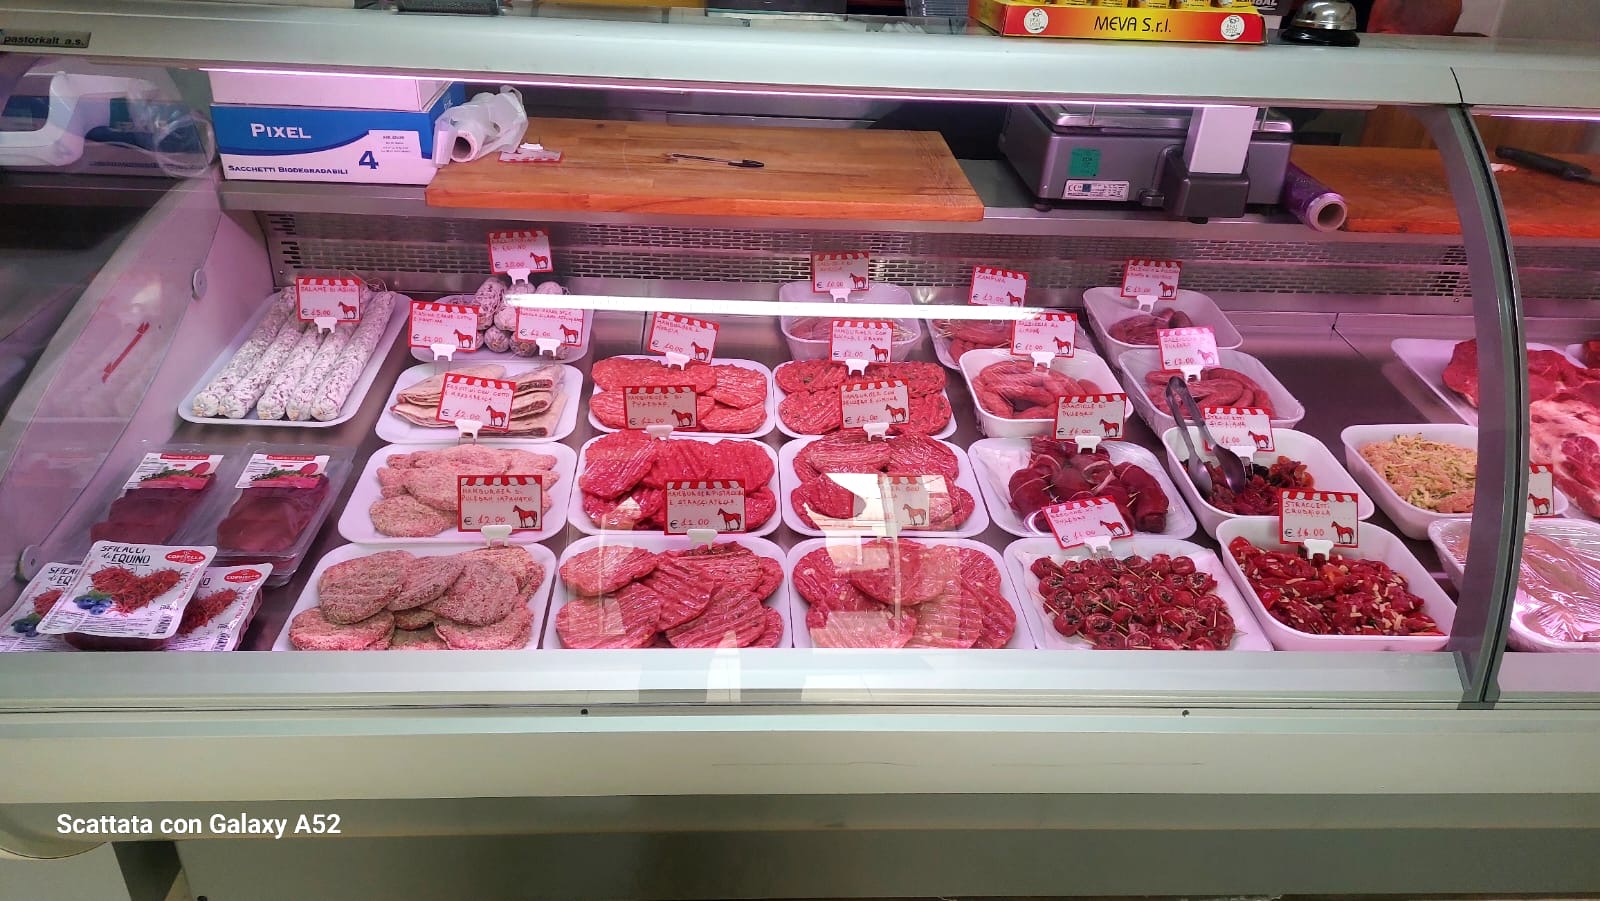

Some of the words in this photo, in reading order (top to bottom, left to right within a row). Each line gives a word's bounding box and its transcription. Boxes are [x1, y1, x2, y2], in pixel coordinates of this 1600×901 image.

[1094, 16, 1138, 31] MEVA
[1142, 17, 1172, 33] S.r.l.
[251, 123, 312, 139] PIXEL
[358, 151, 379, 170] 4
[228, 165, 276, 173] SACCHETTI
[278, 167, 349, 175] BIODEGRADABILI
[973, 293, 980, 301] €
[302, 308, 309, 316] €
[519, 328, 527, 336] €
[413, 333, 420, 342] €
[651, 339, 659, 348] €
[1014, 342, 1022, 350] €
[441, 408, 450, 417] €
[629, 417, 637, 425] €
[845, 416, 853, 425] €
[1057, 427, 1065, 435] €
[461, 487, 511, 496] HAMBURGER
[667, 490, 710, 498] HAMBURGER
[1283, 500, 1329, 509] STRACCETTI
[463, 516, 473, 525] €
[669, 518, 678, 528] €
[1284, 528, 1293, 538] €
[1060, 535, 1070, 543] €
[111, 553, 151, 565] EQUINO
